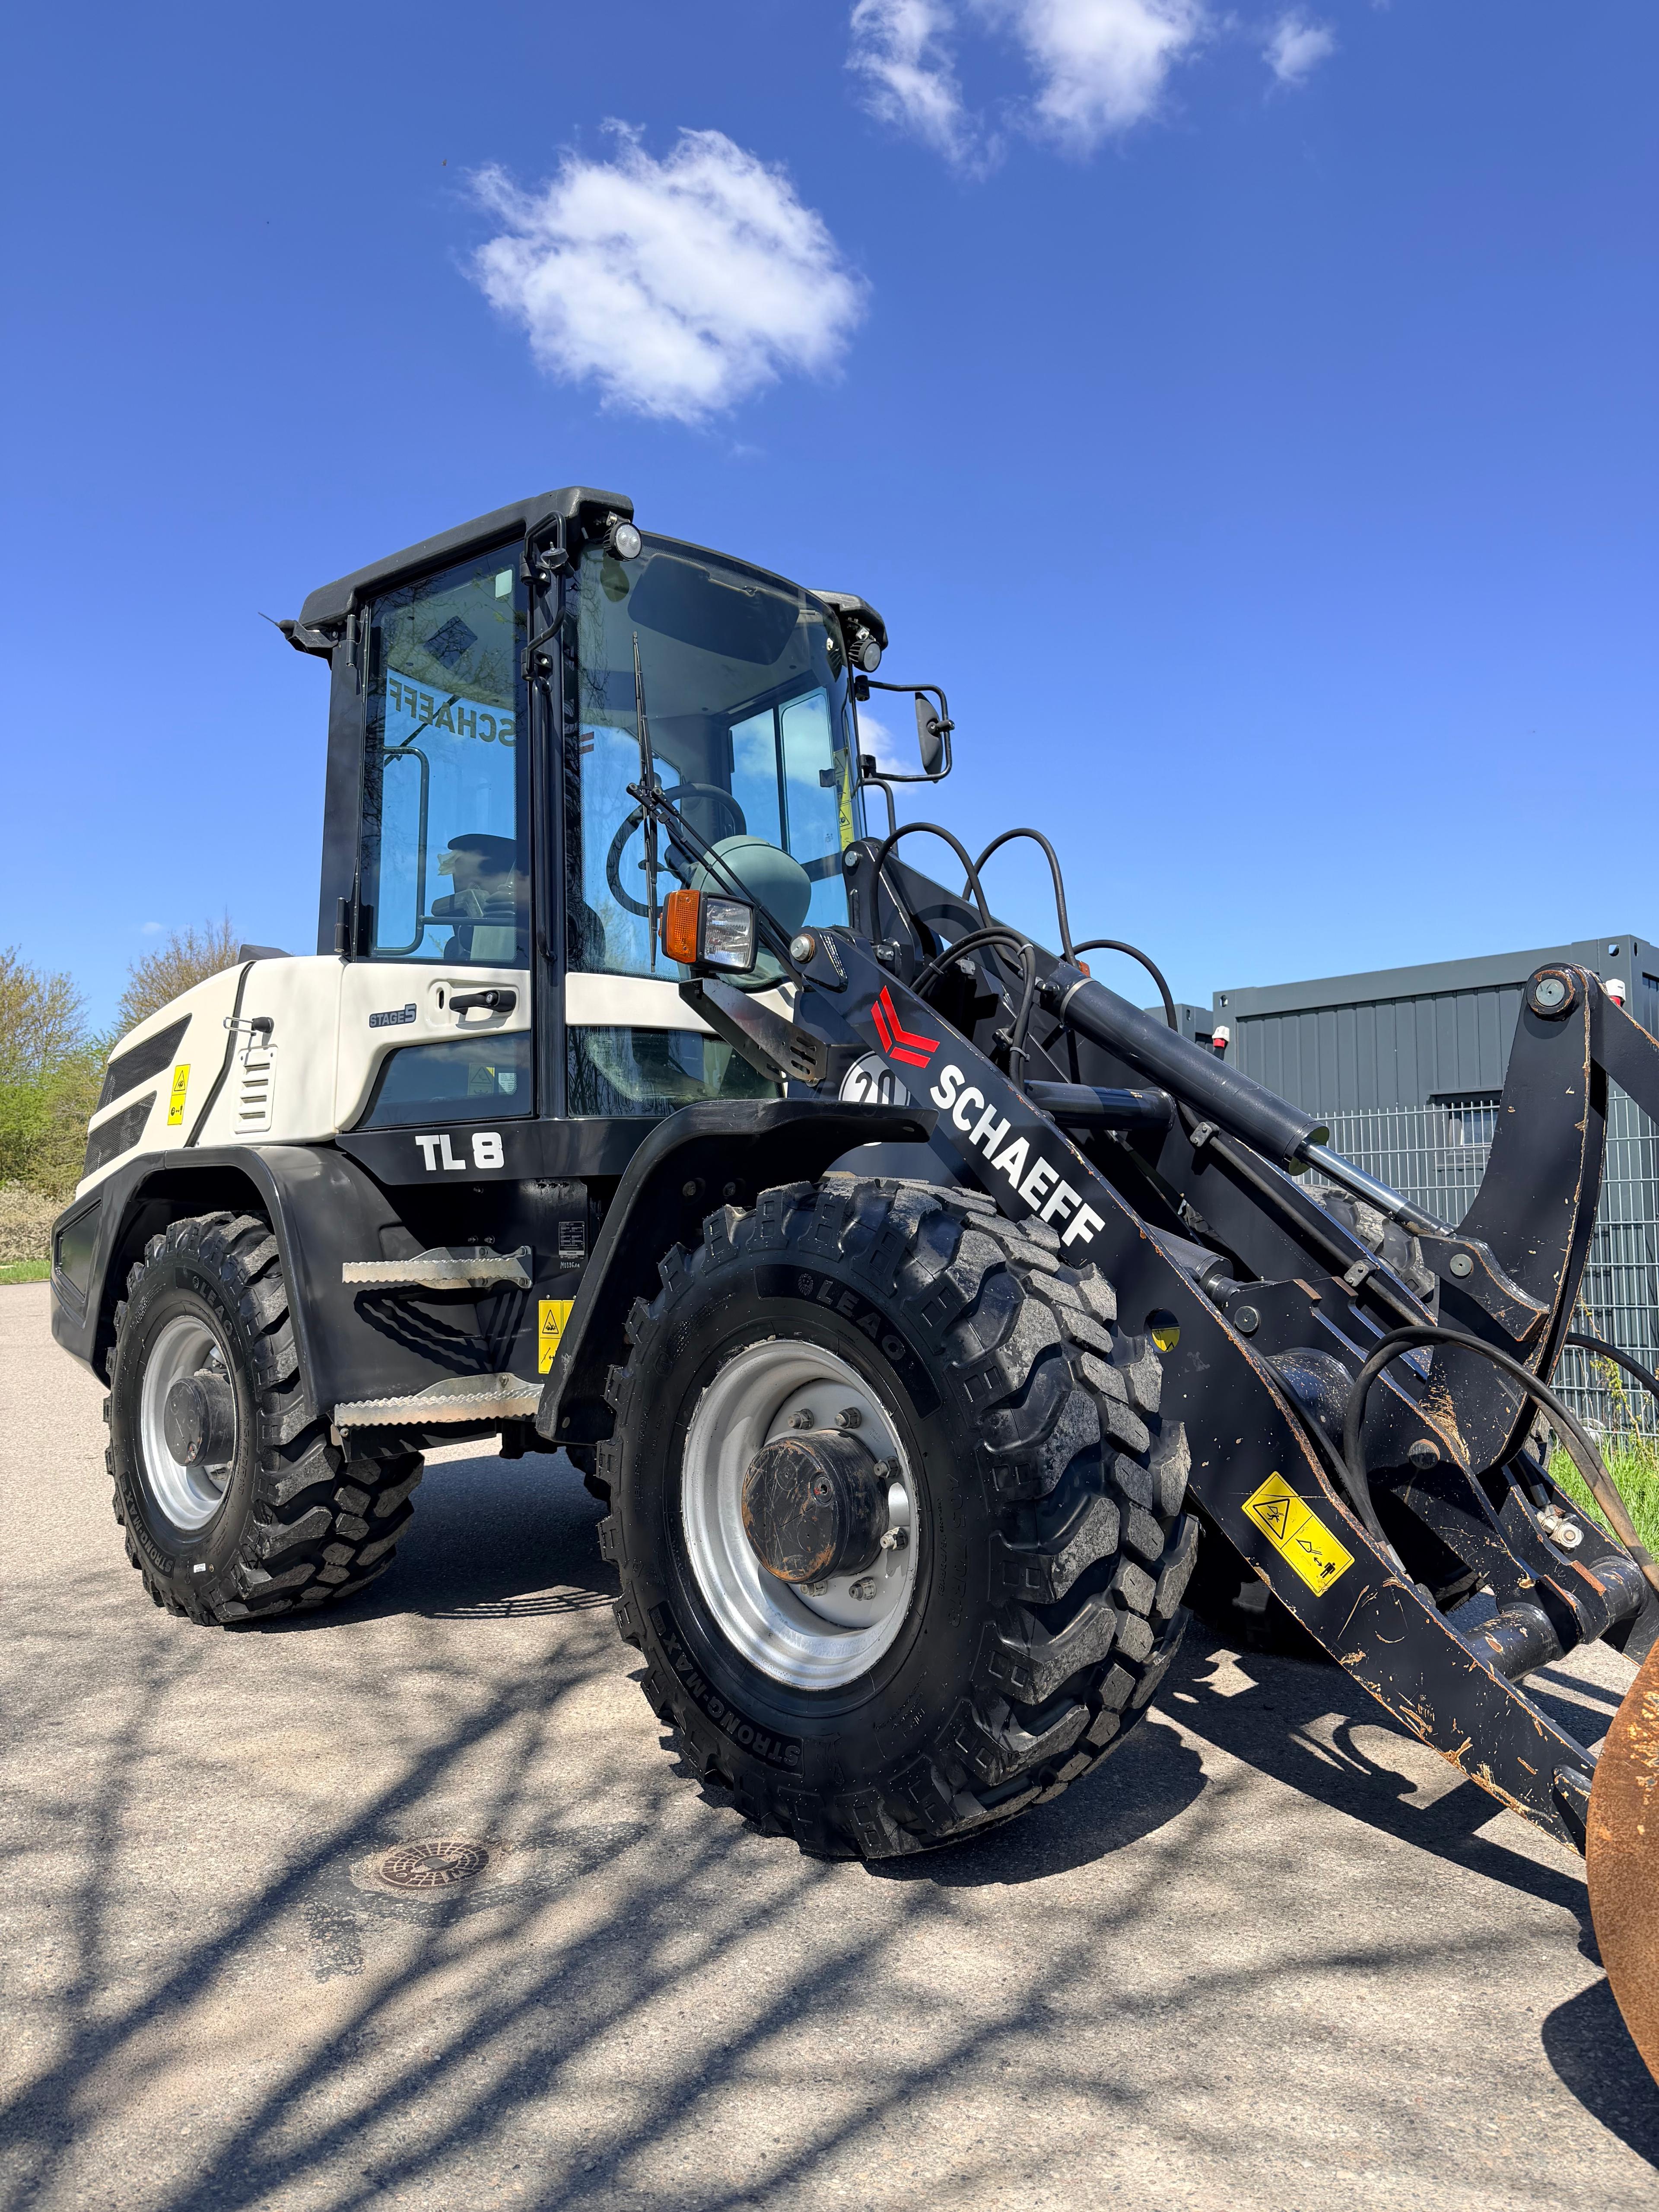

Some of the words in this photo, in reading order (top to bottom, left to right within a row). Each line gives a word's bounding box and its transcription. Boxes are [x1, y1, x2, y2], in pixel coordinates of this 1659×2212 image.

[930, 1065, 1106, 1247] SCHAEFF
[200, 1281, 233, 1336] LEAO
[816, 1279, 906, 1360] LEAO
[124, 1491, 173, 1573] STRONG-MAX
[663, 1632, 801, 1767] STRONG-MAX
